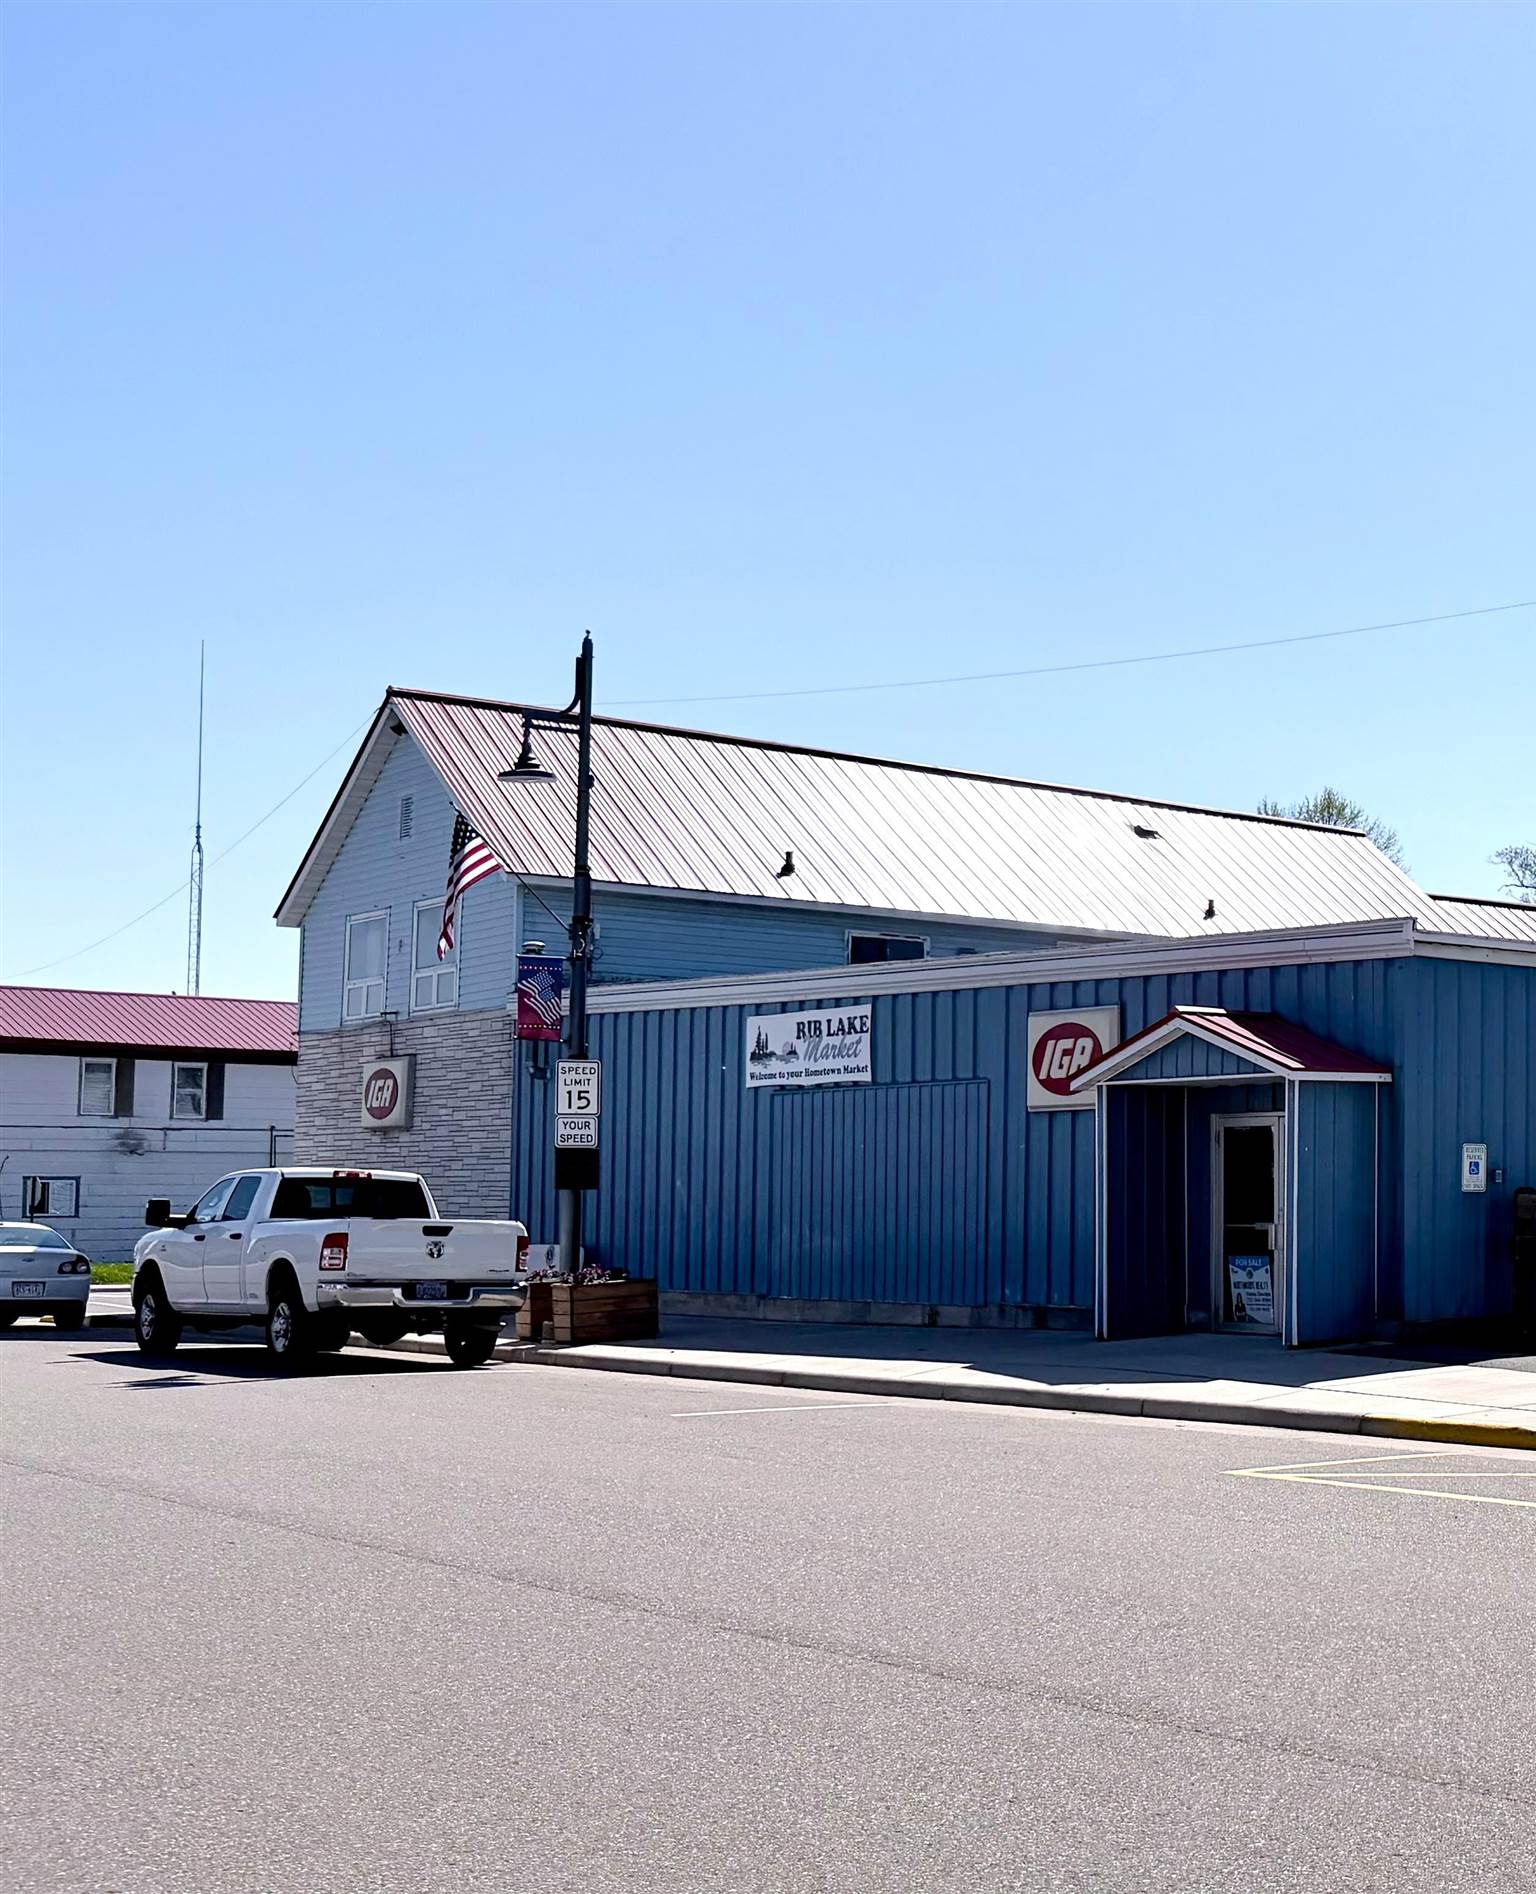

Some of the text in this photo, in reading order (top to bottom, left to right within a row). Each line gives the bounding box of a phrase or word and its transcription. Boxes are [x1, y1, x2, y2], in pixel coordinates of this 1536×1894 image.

[796, 1015, 869, 1039] RIB LAKE
[803, 1033, 862, 1063] Market
[1039, 1036, 1094, 1080] IGA
[560, 1066, 596, 1075] SPEED
[749, 1064, 869, 1081] Welcome to your Hometown Market
[564, 1078, 591, 1086] LIMIT
[366, 1078, 394, 1108] IGA
[566, 1090, 591, 1110] 15
[562, 1121, 591, 1130] YOUR
[560, 1133, 593, 1144] SPEED
